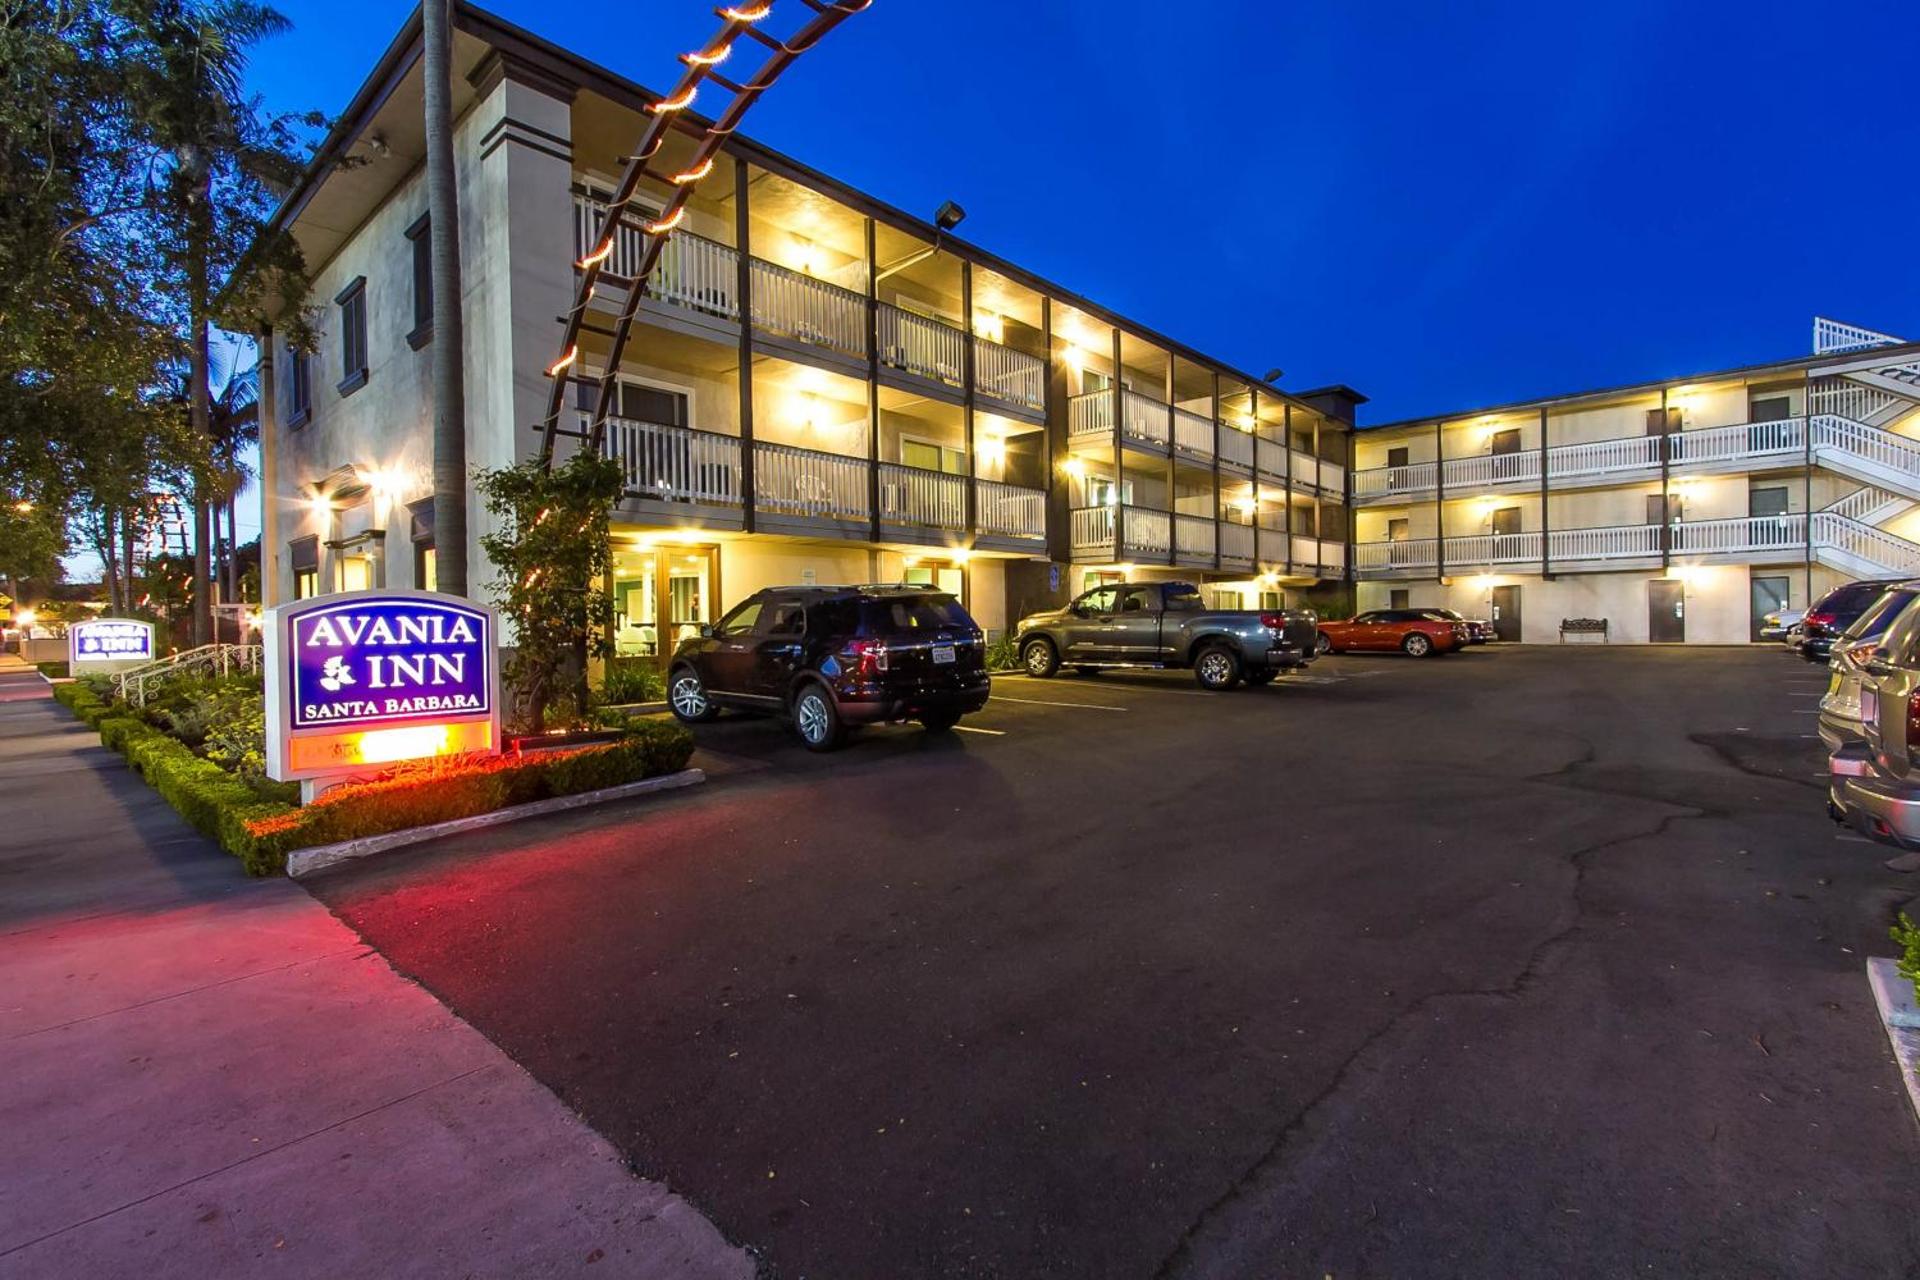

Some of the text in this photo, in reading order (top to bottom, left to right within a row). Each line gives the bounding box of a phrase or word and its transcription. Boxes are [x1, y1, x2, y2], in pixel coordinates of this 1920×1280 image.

[306, 616, 477, 646] AVANIA
[366, 653, 466, 688] INN
[305, 694, 480, 719] SANTA BARBARA
